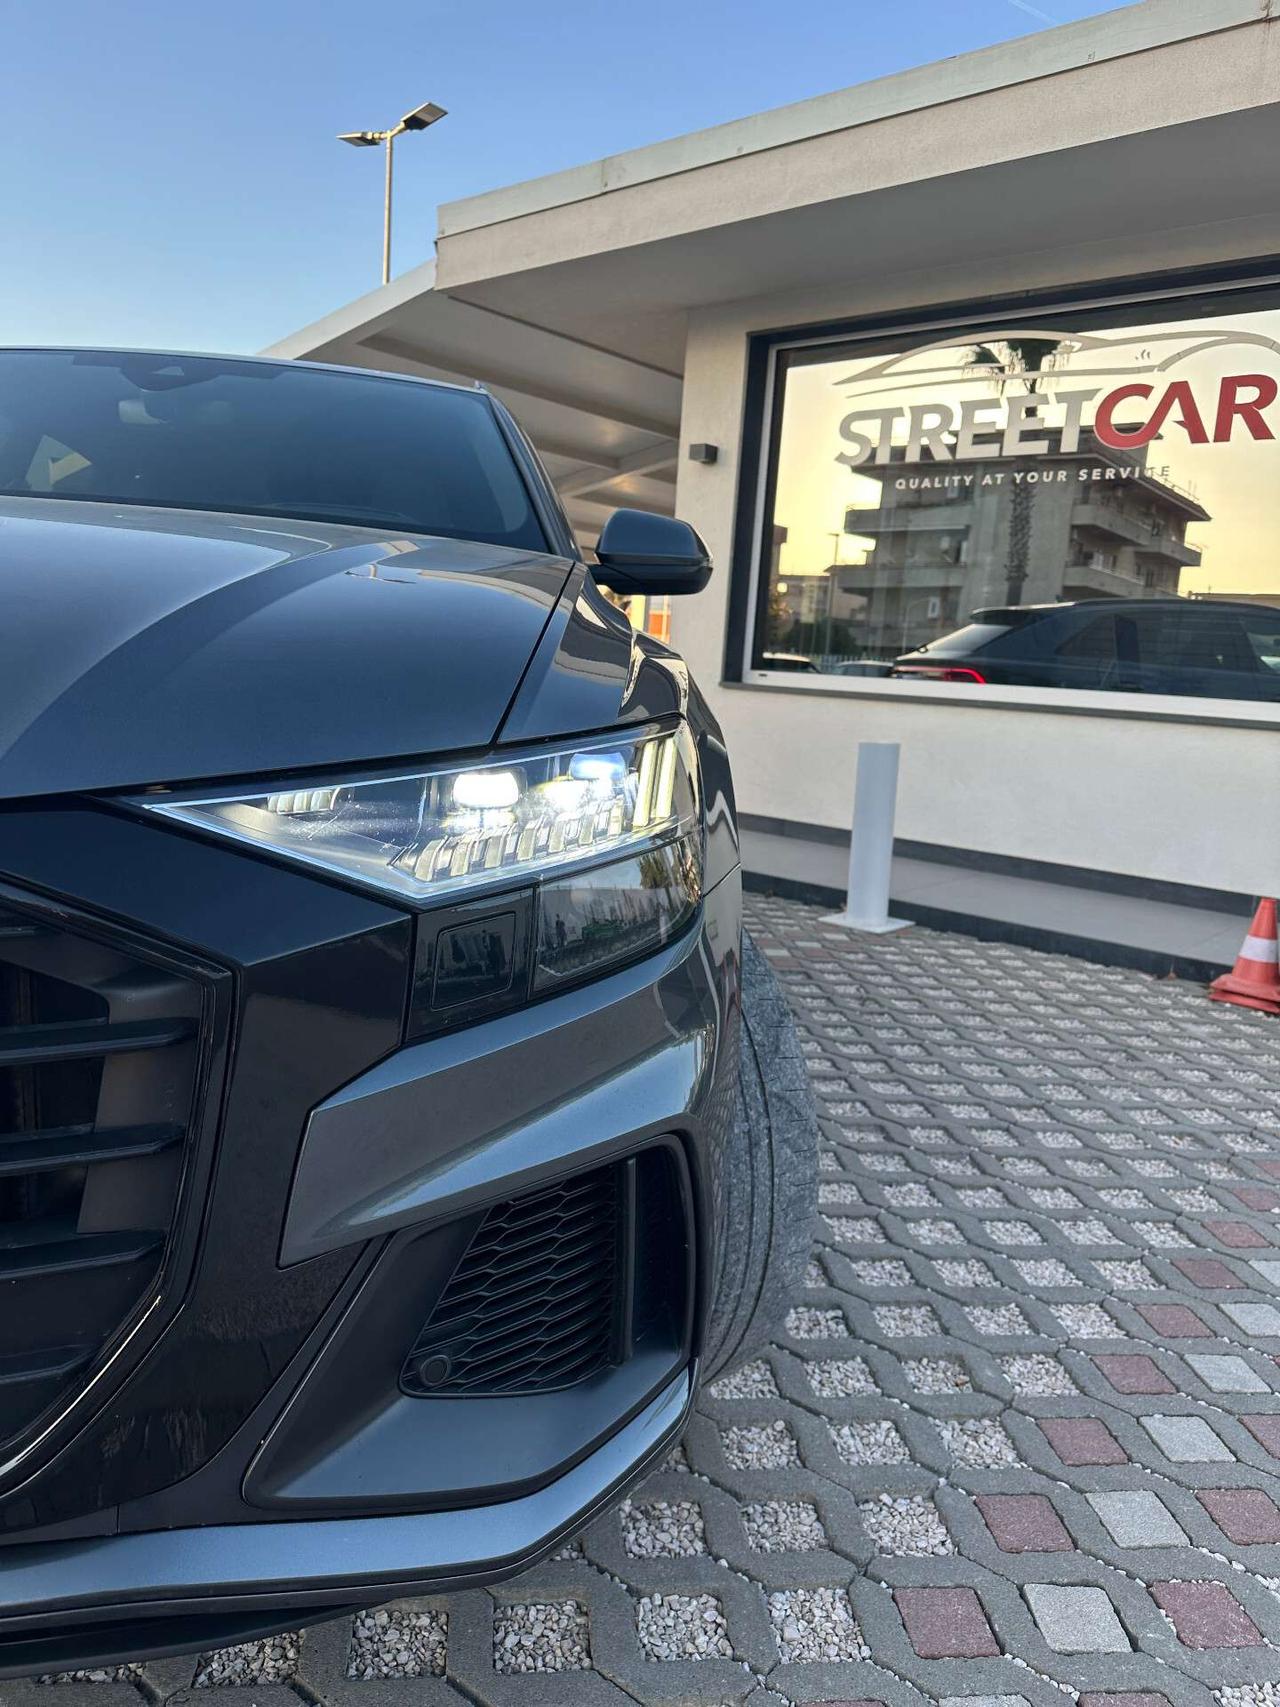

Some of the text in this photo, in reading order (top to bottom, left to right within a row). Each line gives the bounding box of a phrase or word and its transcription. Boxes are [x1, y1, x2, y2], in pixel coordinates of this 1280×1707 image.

[894, 475, 974, 490] QUALITY
[981, 473, 1005, 486] AT
[1013, 470, 1068, 484] YOUR
